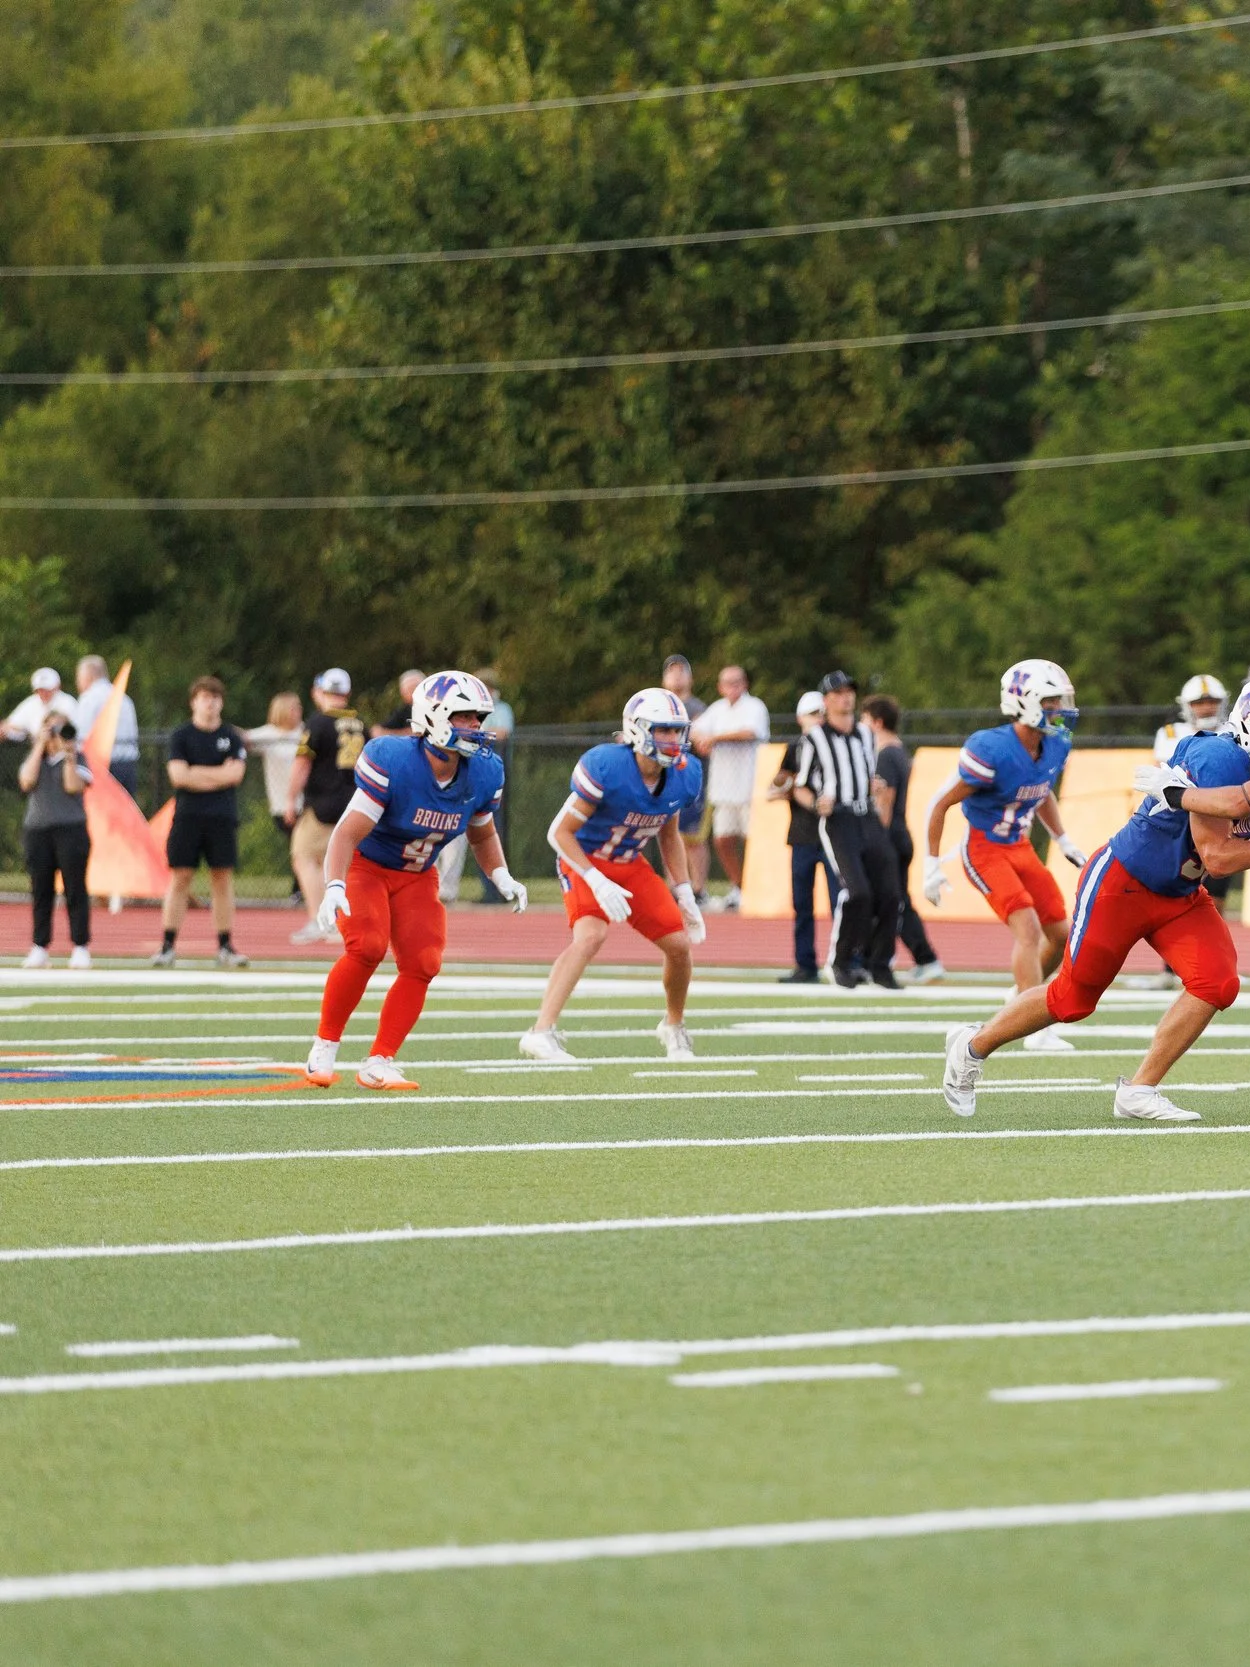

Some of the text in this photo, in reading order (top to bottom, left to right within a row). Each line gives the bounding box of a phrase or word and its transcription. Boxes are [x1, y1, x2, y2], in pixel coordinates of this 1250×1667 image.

[425, 675, 457, 702] N
[412, 808, 462, 830] BRUINS
[624, 811, 669, 826] BRUINS
[402, 832, 445, 873] 4
